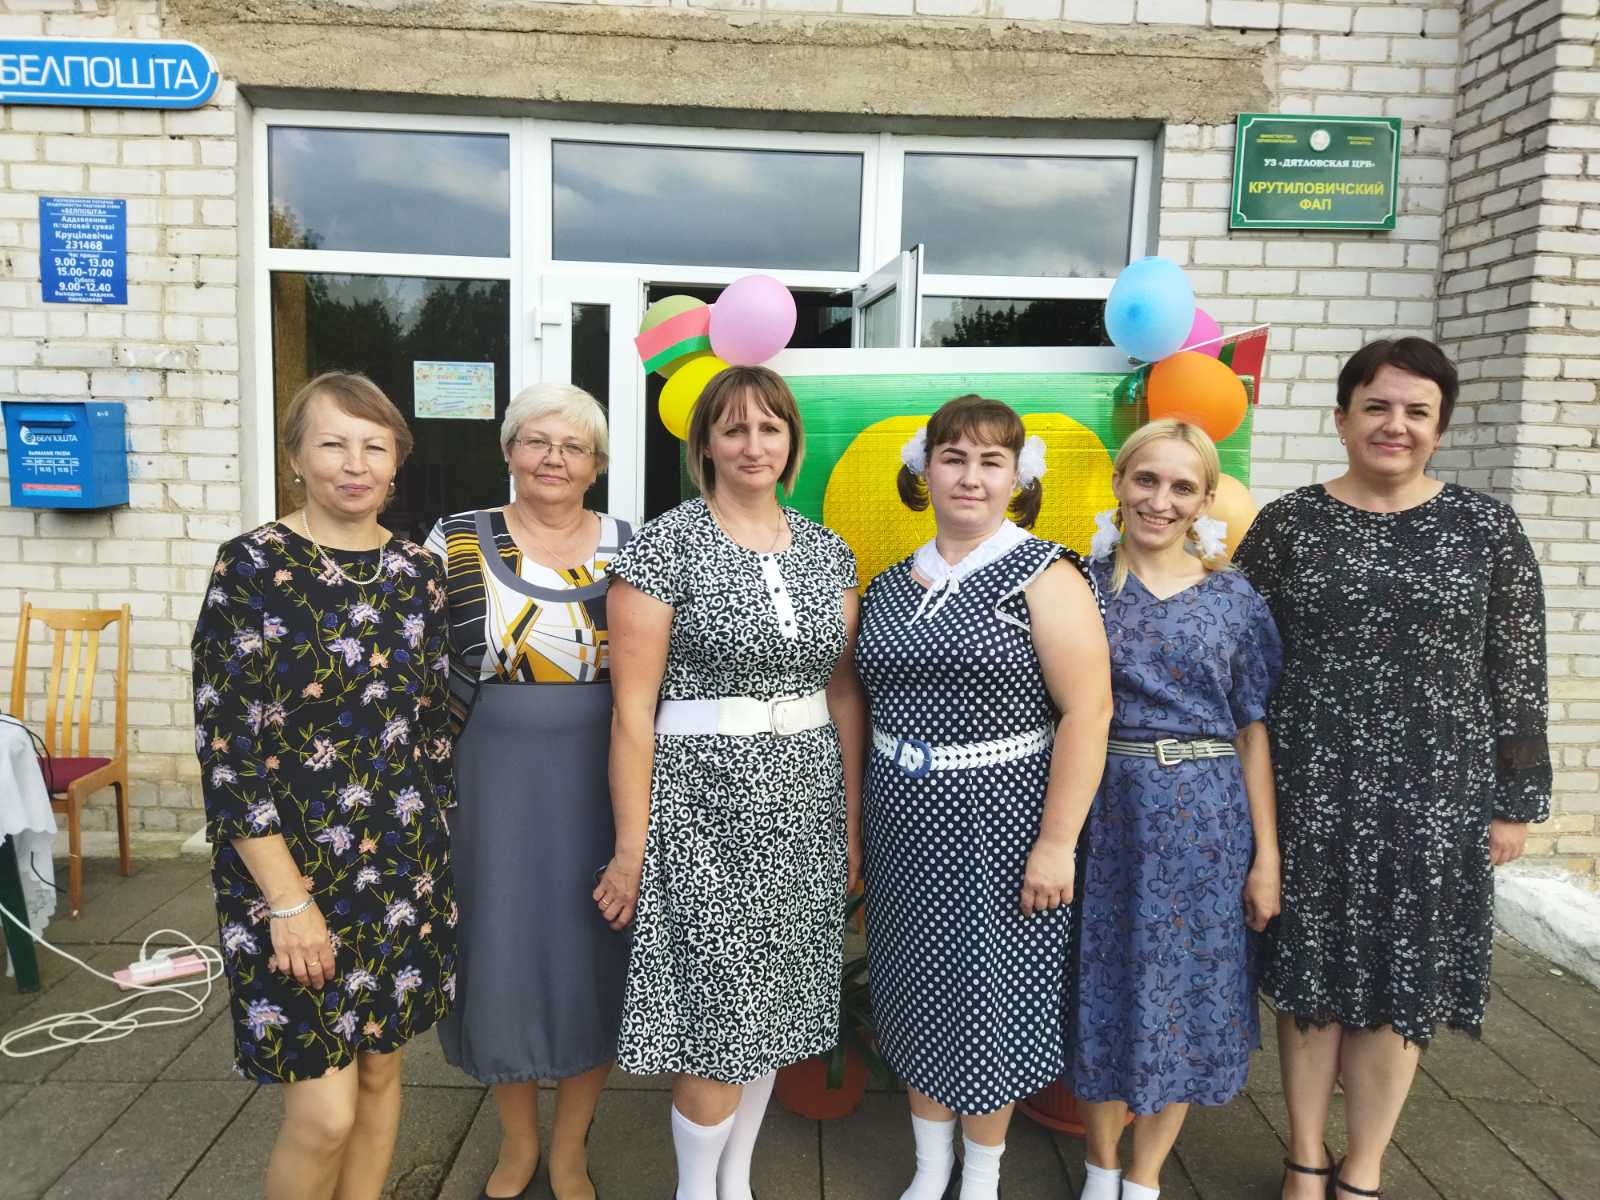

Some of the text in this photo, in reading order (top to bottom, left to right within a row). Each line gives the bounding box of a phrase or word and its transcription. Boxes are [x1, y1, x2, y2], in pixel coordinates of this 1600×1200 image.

[0, 54, 199, 89] БЕЛПОШТА
[1264, 158, 1277, 167] УЗ
[1248, 181, 1384, 195] КРУТИЛОВИЧСКИЙ
[1299, 198, 1332, 210] ФАП
[65, 240, 103, 250] 231468
[54, 257, 77, 266] 9.00
[89, 258, 114, 268] 13.00
